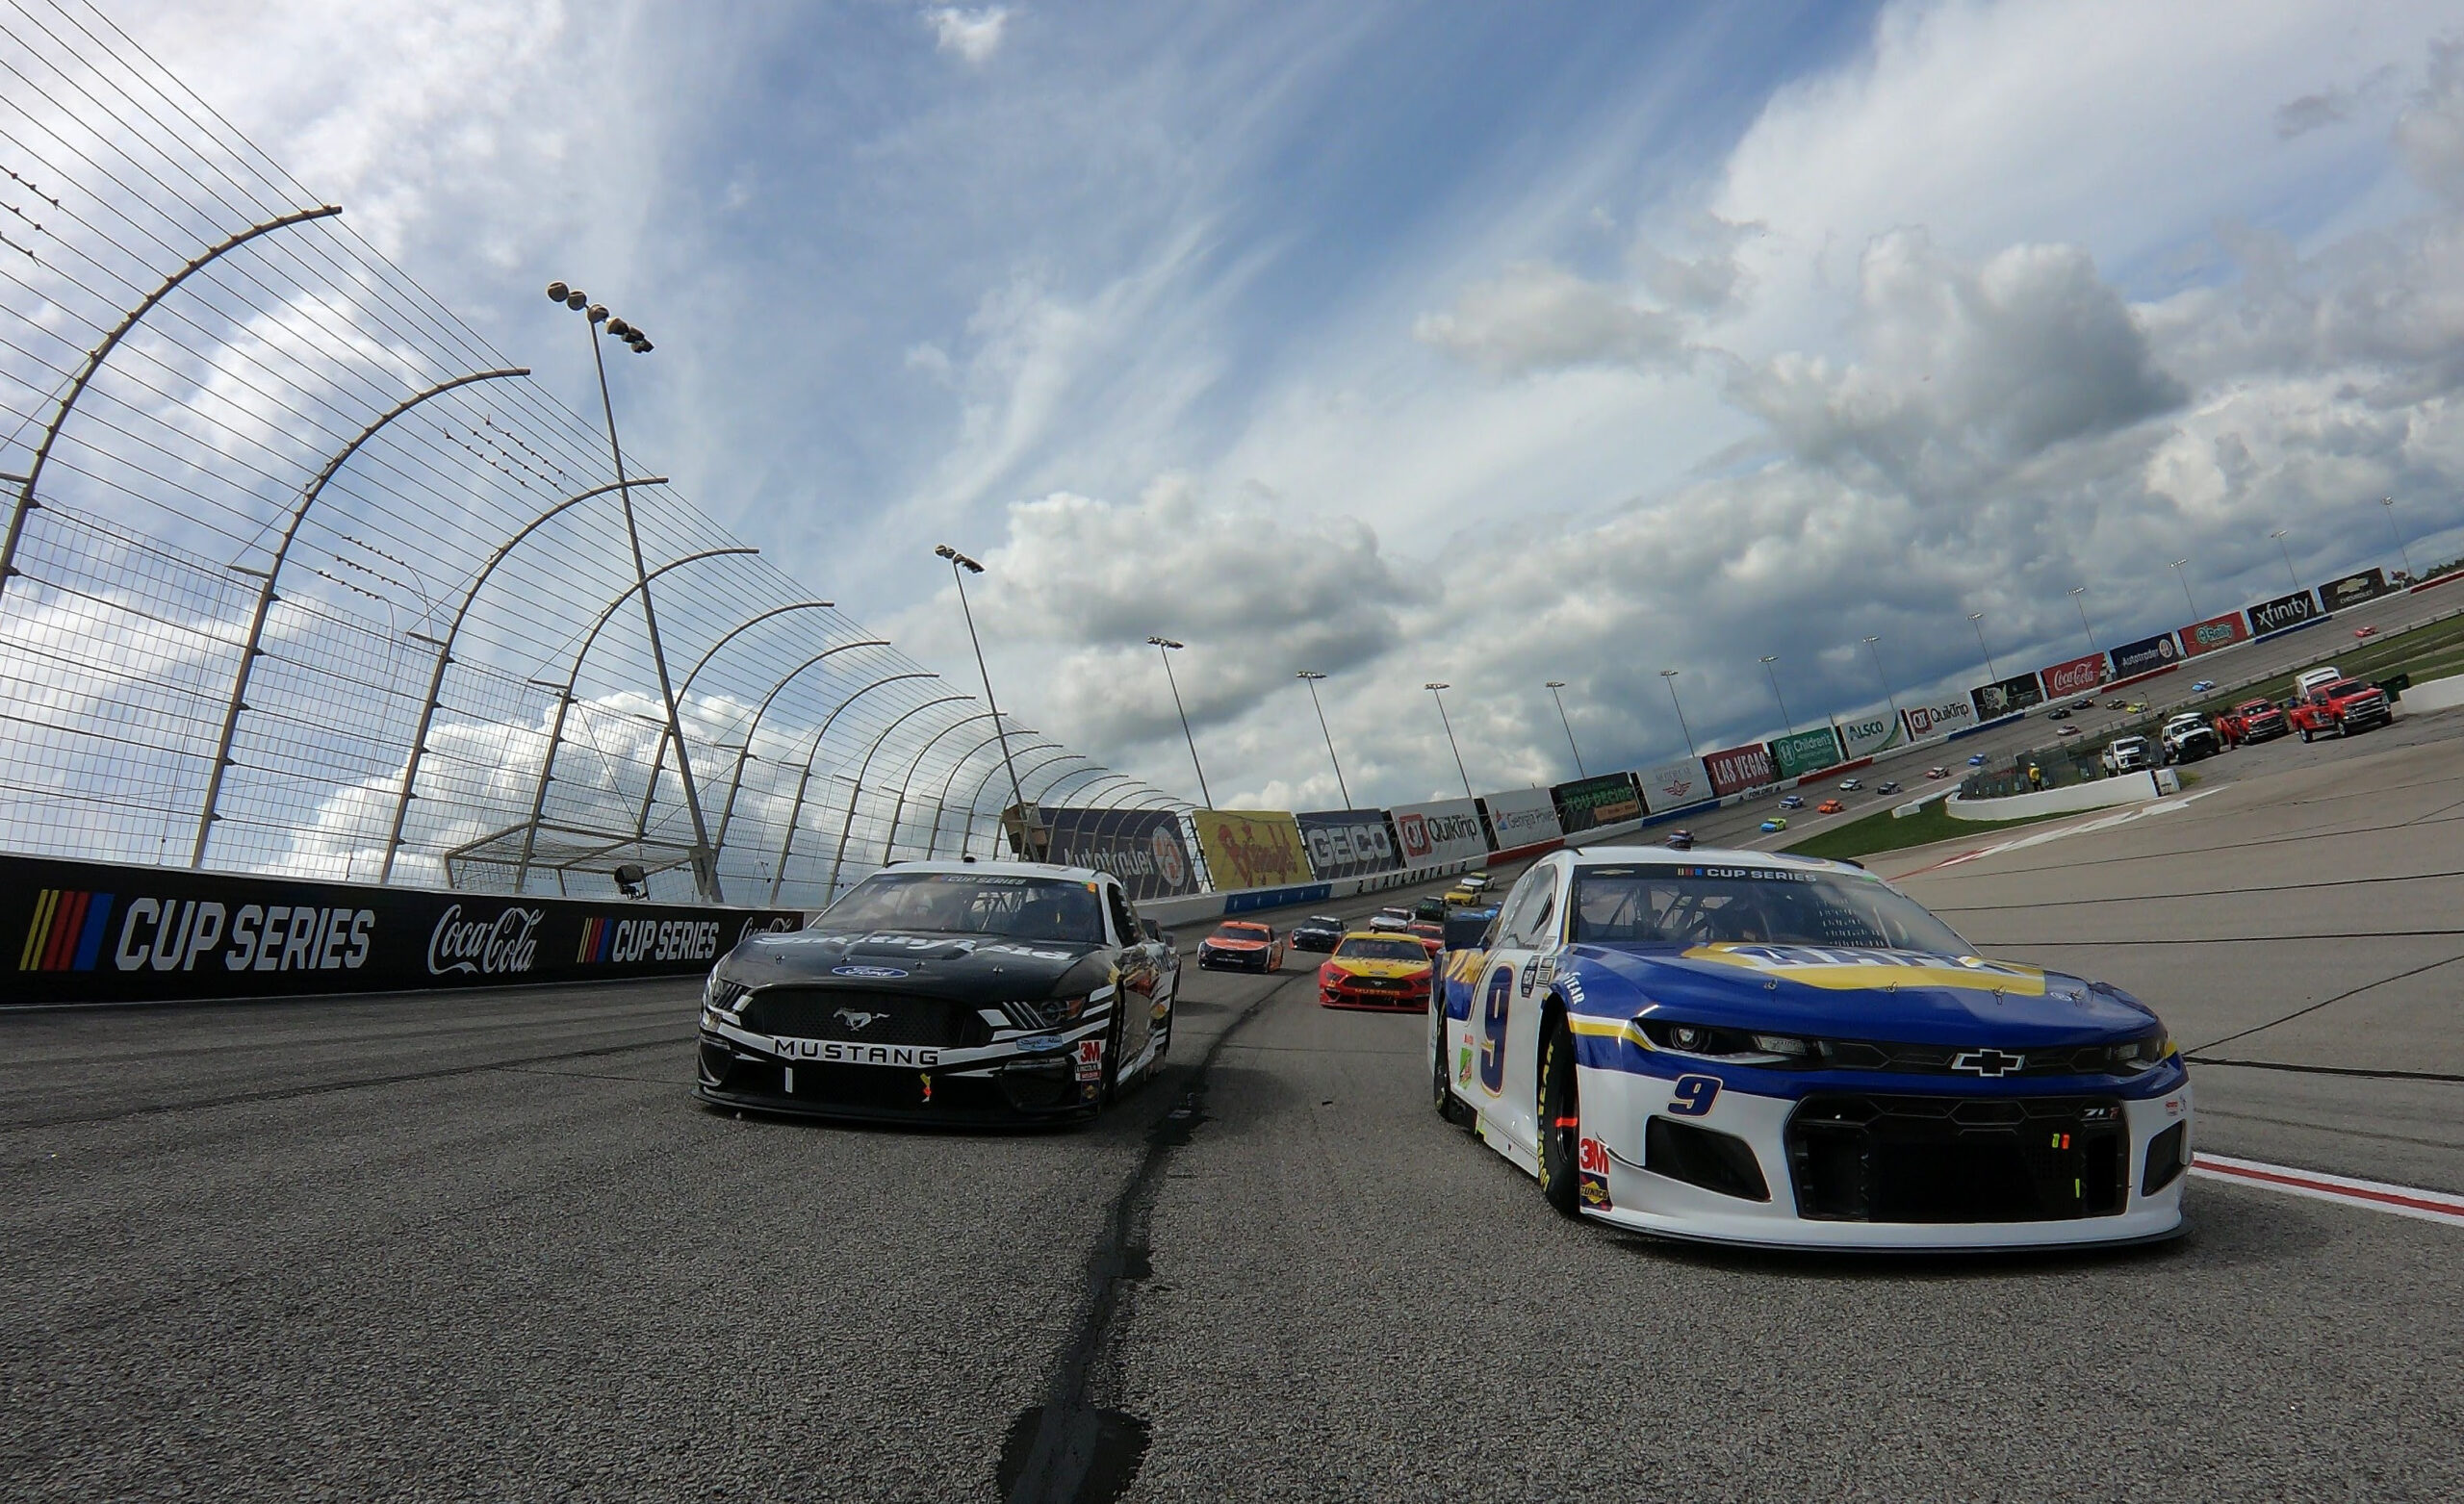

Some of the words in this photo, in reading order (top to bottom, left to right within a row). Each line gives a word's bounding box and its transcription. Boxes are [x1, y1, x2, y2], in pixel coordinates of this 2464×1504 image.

[2256, 597, 2309, 628] xfinity
[2122, 649, 2159, 667] Autotrader
[1930, 701, 1969, 724] QuikTrip
[1712, 757, 1736, 785] LAS
[1735, 751, 1770, 780] VEGAS
[1427, 813, 1478, 843] QuikTrip
[1065, 843, 1155, 878] Autotrader
[1307, 824, 1392, 868] GEICO
[947, 875, 976, 883] CUP
[976, 877, 1028, 885] SERIES
[1383, 865, 1443, 889] ATLANTA
[1707, 868, 1746, 879] CUP
[1750, 870, 1818, 883] SERIES
[115, 897, 226, 971] CUP
[225, 905, 376, 972] SERIES
[427, 904, 546, 976] Coca-Cola
[612, 919, 658, 962] CUP
[657, 920, 720, 961] SERIES
[1480, 961, 1516, 1098] 9
[774, 1039, 938, 1065] MUSTANG
[1080, 1040, 1101, 1063] 3M
[1667, 1073, 1724, 1119] 9
[1580, 1137, 1609, 1175] 3M
